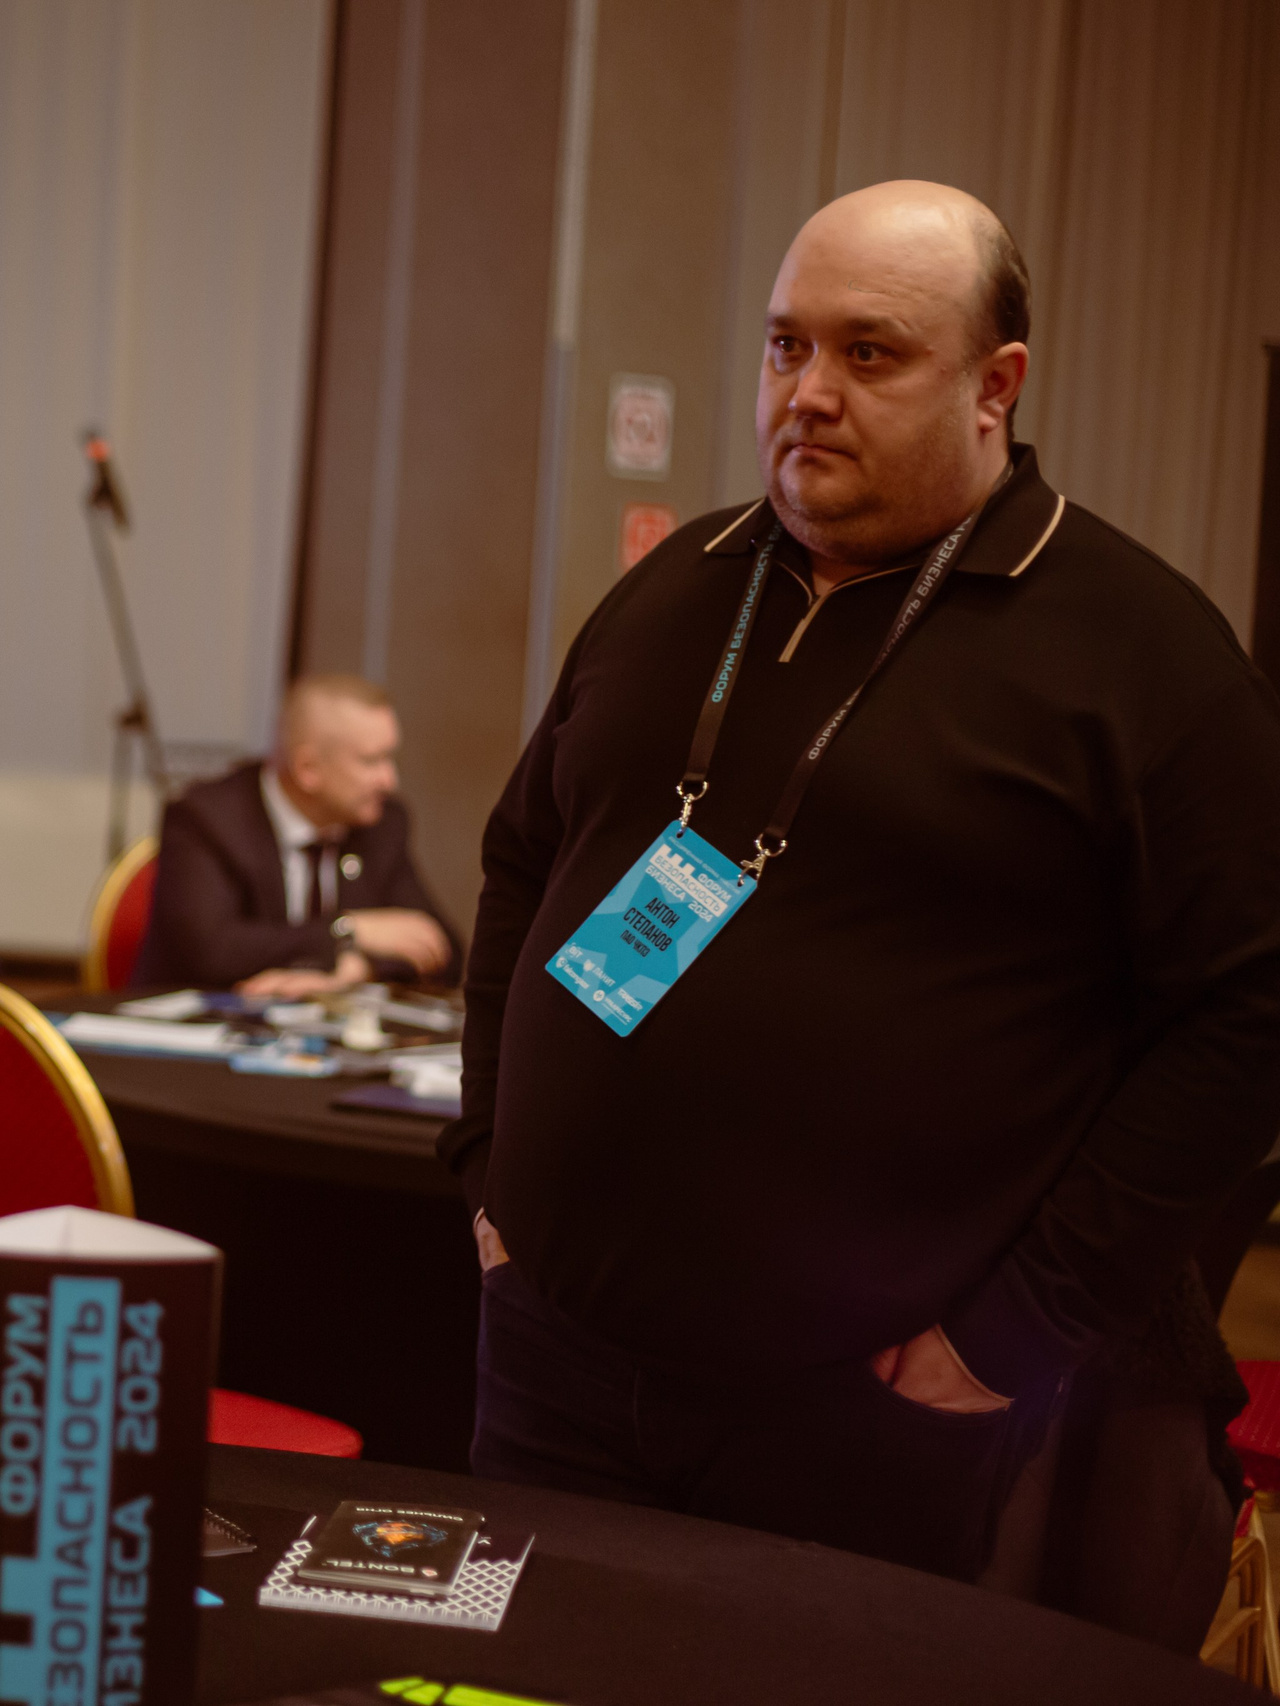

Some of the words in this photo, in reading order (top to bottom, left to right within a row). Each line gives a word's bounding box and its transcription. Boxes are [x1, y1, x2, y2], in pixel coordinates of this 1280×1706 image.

[712, 652, 737, 702] ФОРУМ
[731, 541, 773, 649] БЕЗОПАСНОСТЬ
[808, 709, 846, 760] ФОРУМ
[916, 534, 962, 597] БИЗНЕСА
[644, 864, 687, 901] БИЗНЕСА
[687, 899, 713, 923] 2024
[653, 855, 722, 912] БЕЗОПАСНОСТЬ
[696, 872, 731, 902] ФОРУМ
[619, 929, 636, 945] ПАО
[622, 906, 673, 952] СТЕПАНОВ
[644, 896, 680, 928] АНТОН
[117, 1301, 164, 1454] 2024
[326, 1559, 415, 1573] BONTEL
